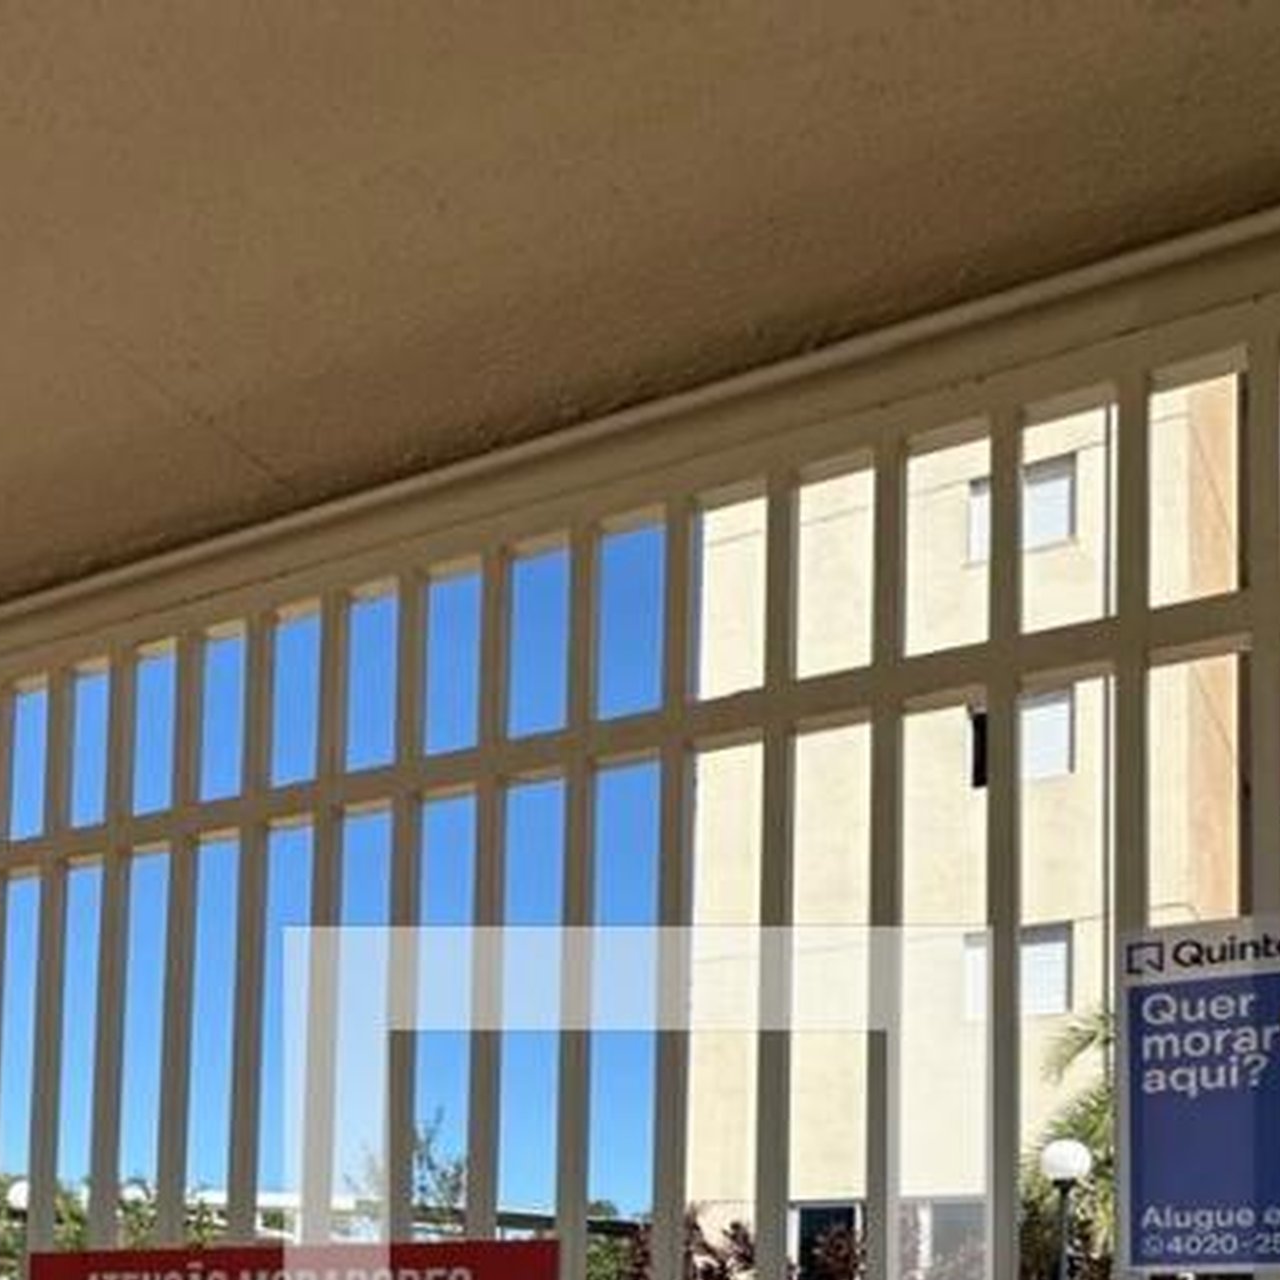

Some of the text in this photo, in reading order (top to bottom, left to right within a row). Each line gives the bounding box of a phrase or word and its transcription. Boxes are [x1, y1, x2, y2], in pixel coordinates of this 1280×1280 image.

[1142, 992, 1255, 1025] Quer
[1142, 1024, 1280, 1060] morar
[1142, 1055, 1268, 1098] aqui?
[1142, 1204, 1254, 1232] Alugue
